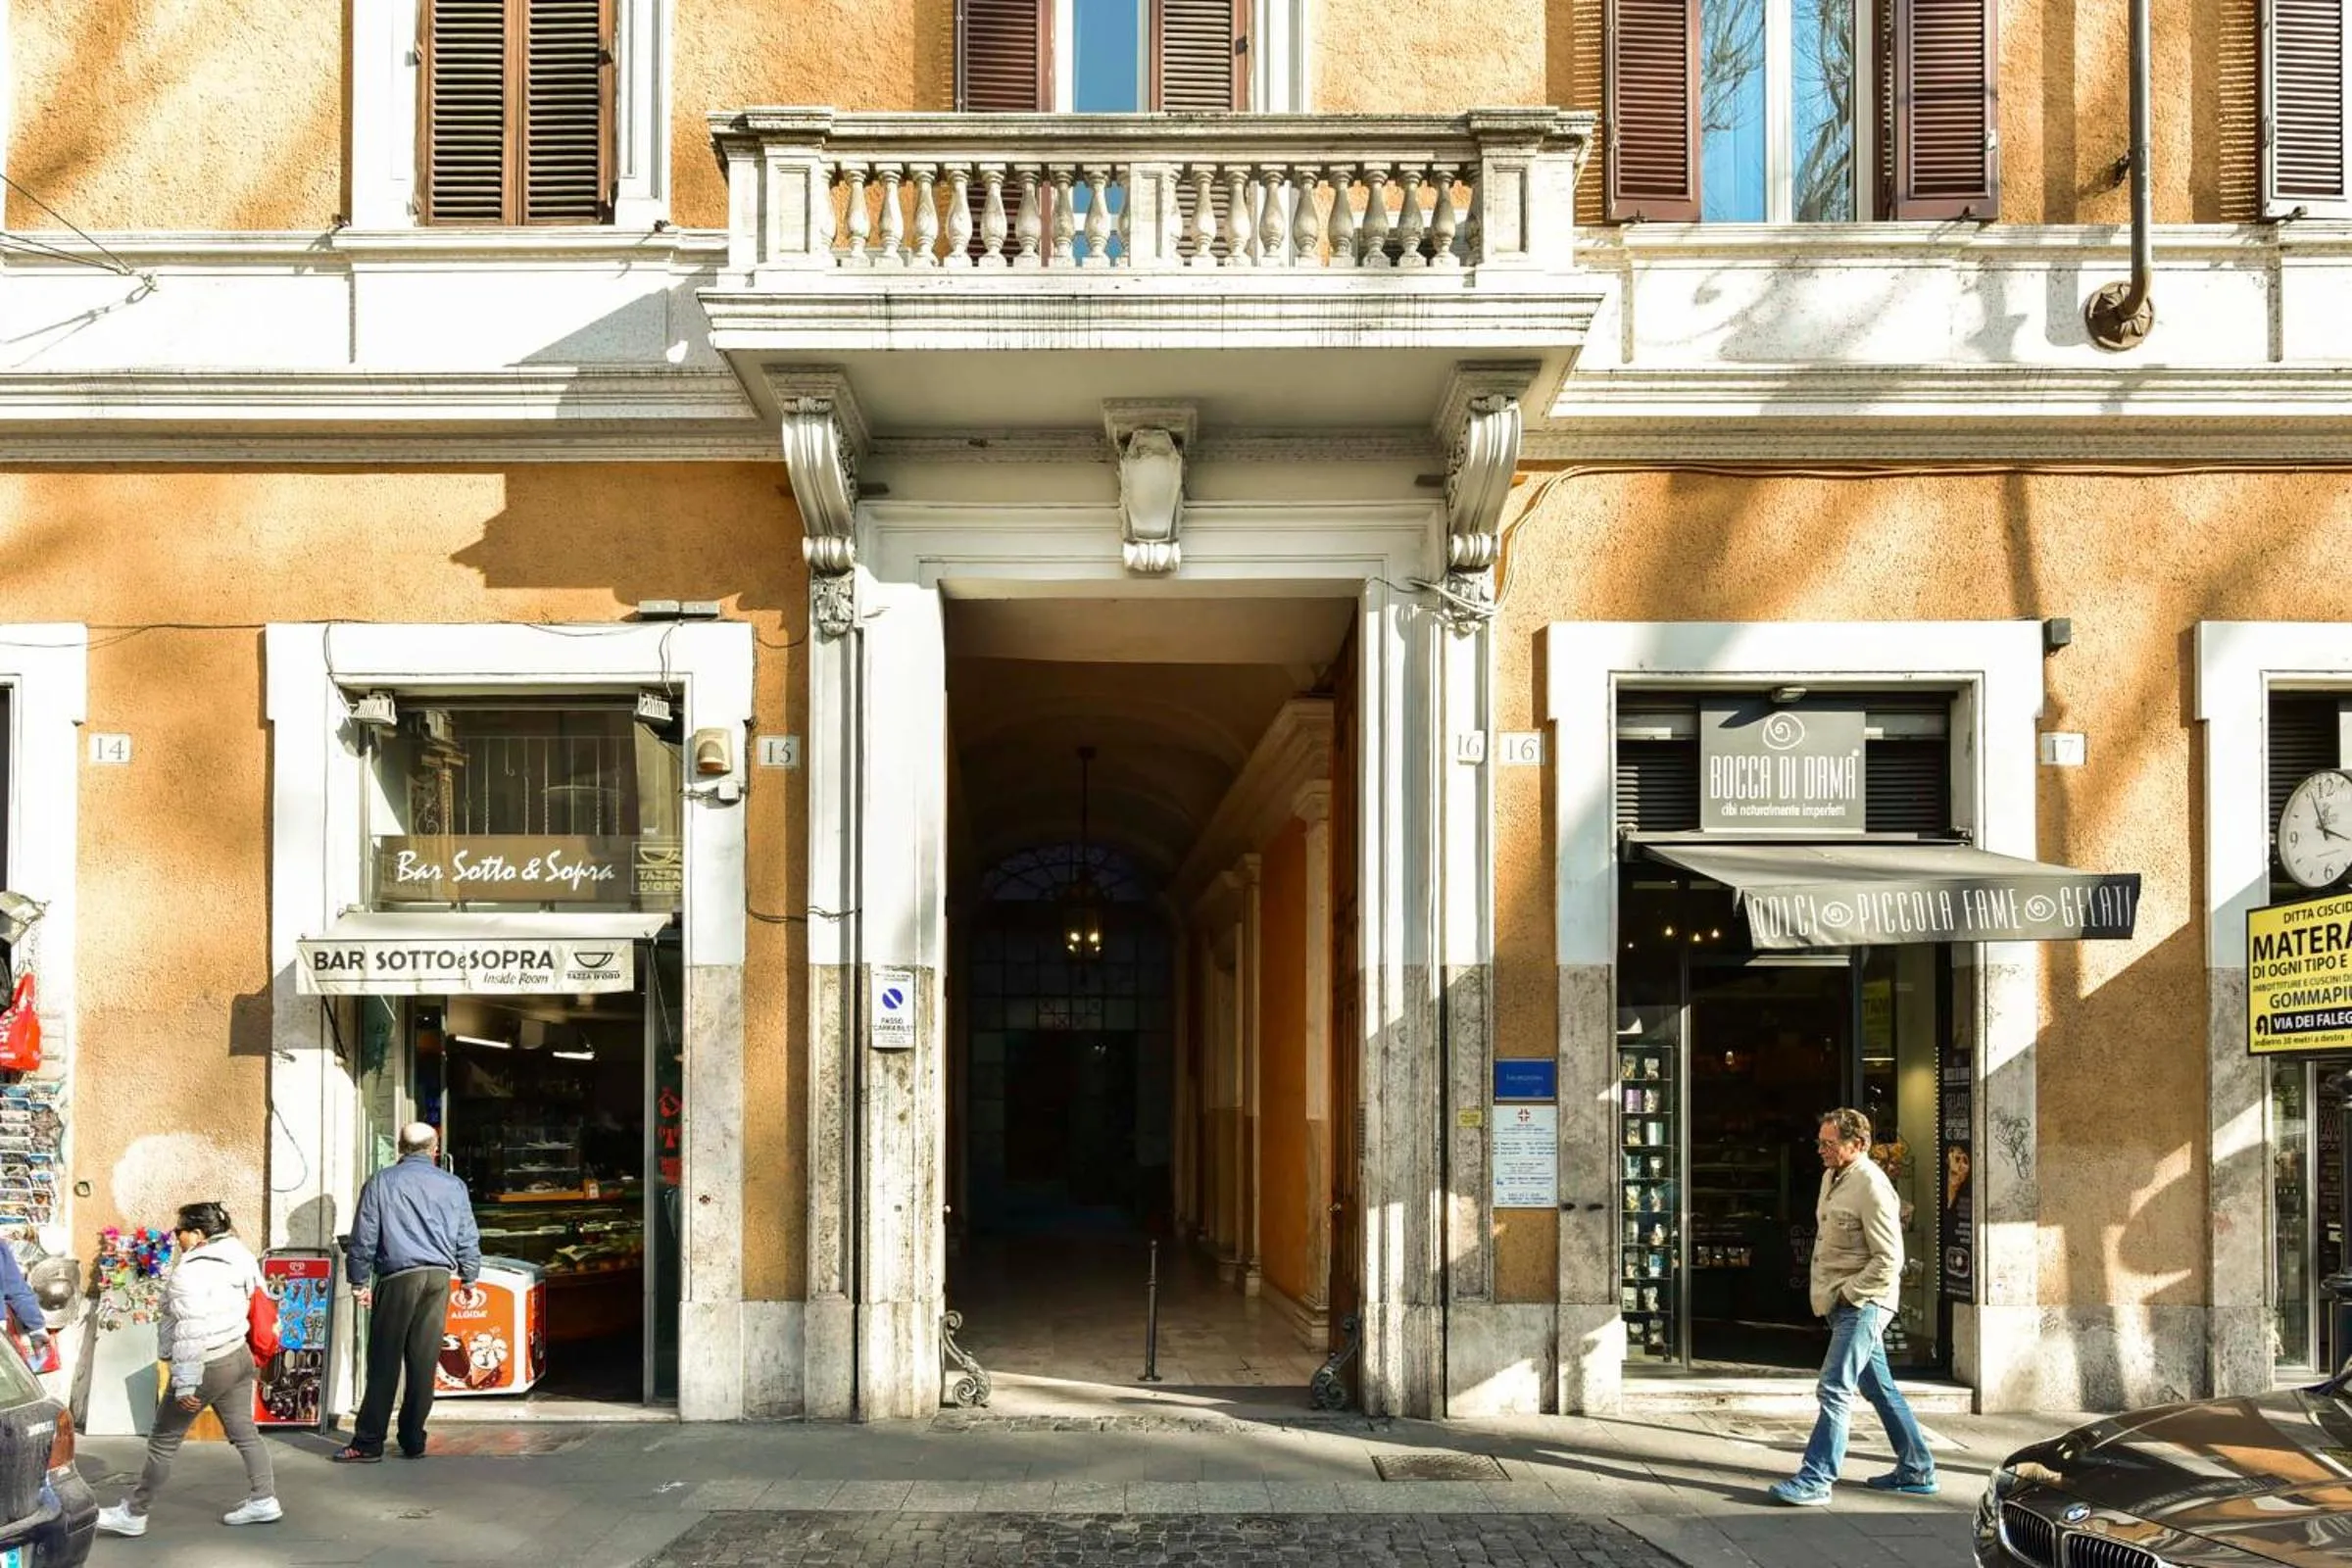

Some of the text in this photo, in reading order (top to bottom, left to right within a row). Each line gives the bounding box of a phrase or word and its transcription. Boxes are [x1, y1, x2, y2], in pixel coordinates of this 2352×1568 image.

[97, 737, 124, 760] 14
[768, 741, 791, 763] 15
[1457, 734, 1480, 757] 16
[1509, 738, 1538, 760] 16
[2052, 739, 2075, 761] 17
[1710, 755, 1856, 800] BOCCA DI DAMA
[1721, 802, 1845, 817] cibi naturalmente imperfetti
[397, 850, 615, 891] Bar Sotto & Sopra
[1751, 886, 2131, 939] DOLCI PICCOLA FAME GELATI
[2283, 907, 2315, 924] DITTA
[314, 951, 365, 971] BAR
[2253, 954, 2348, 979] DI OGNI TIPO E
[483, 972, 549, 985] Inside Room
[2274, 1016, 2293, 1030] VIA
[2295, 1014, 2314, 1028] DEI
